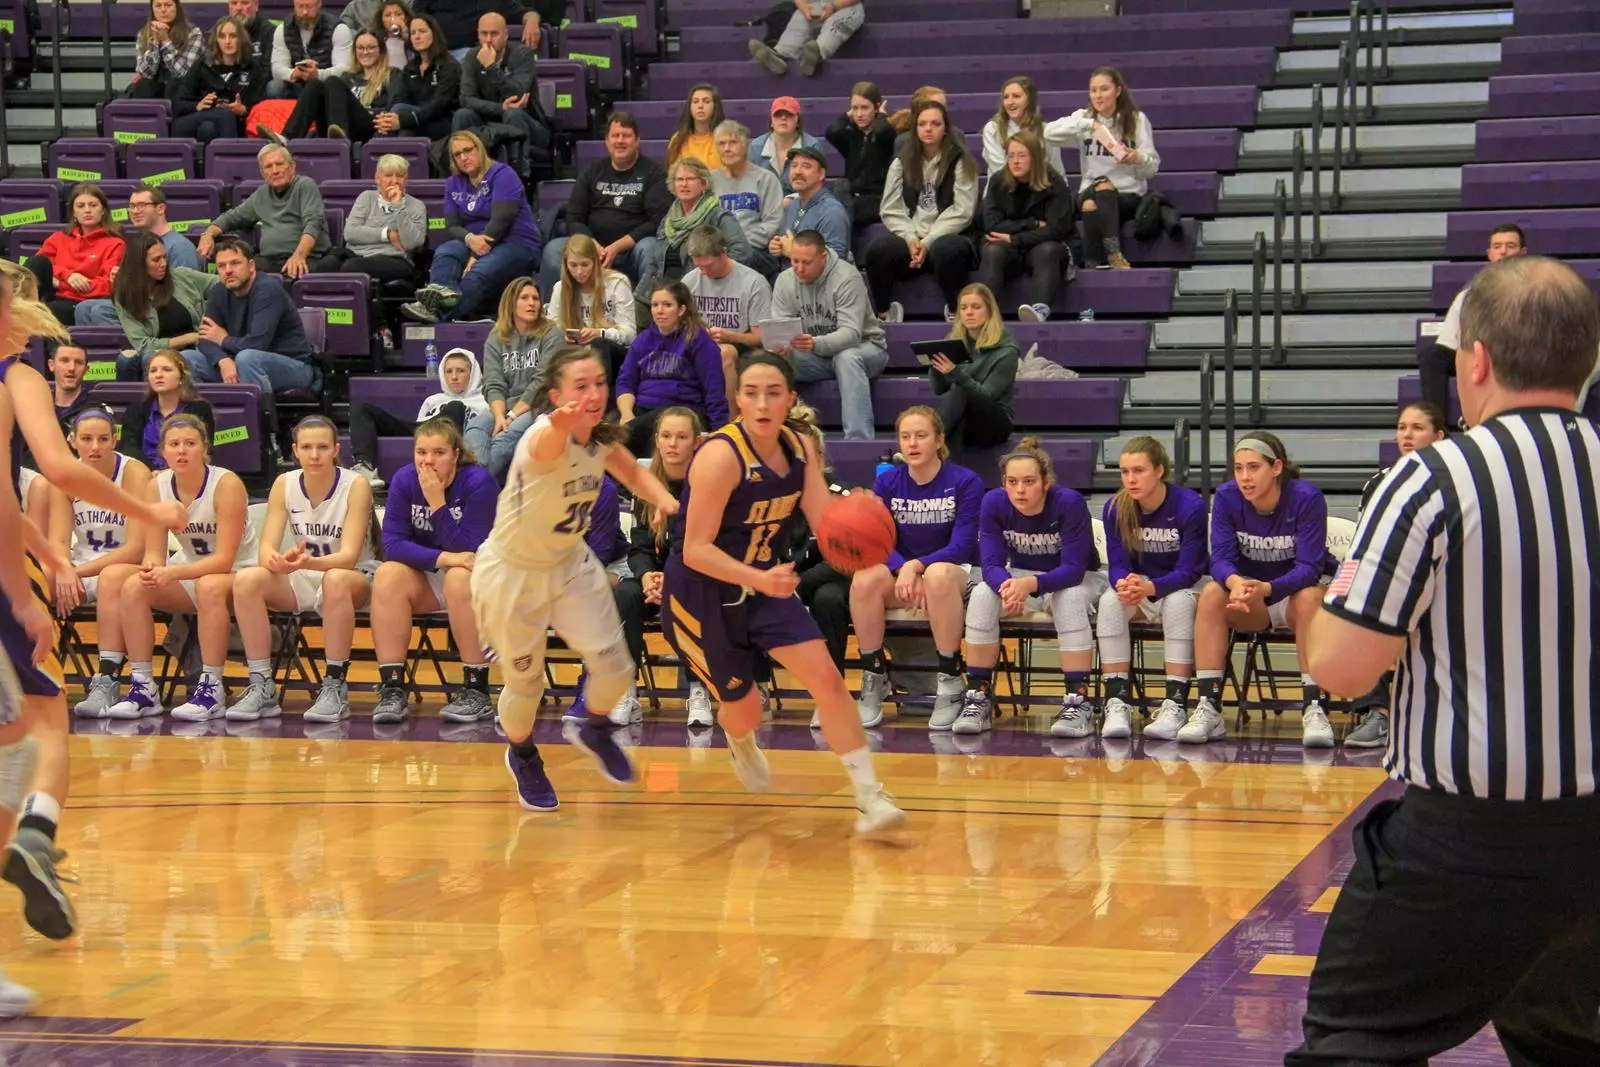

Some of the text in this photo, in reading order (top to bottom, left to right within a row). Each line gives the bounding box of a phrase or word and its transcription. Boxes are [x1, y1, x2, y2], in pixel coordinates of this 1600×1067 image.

[693, 295, 741, 313] NIVERSITY
[706, 313, 740, 329] THOMAS
[891, 495, 956, 513] ST. THOMAS
[87, 510, 126, 526] THOMAS
[182, 522, 217, 534] HOMAS
[305, 522, 343, 539] THOMAS
[1140, 527, 1180, 542] OMAS
